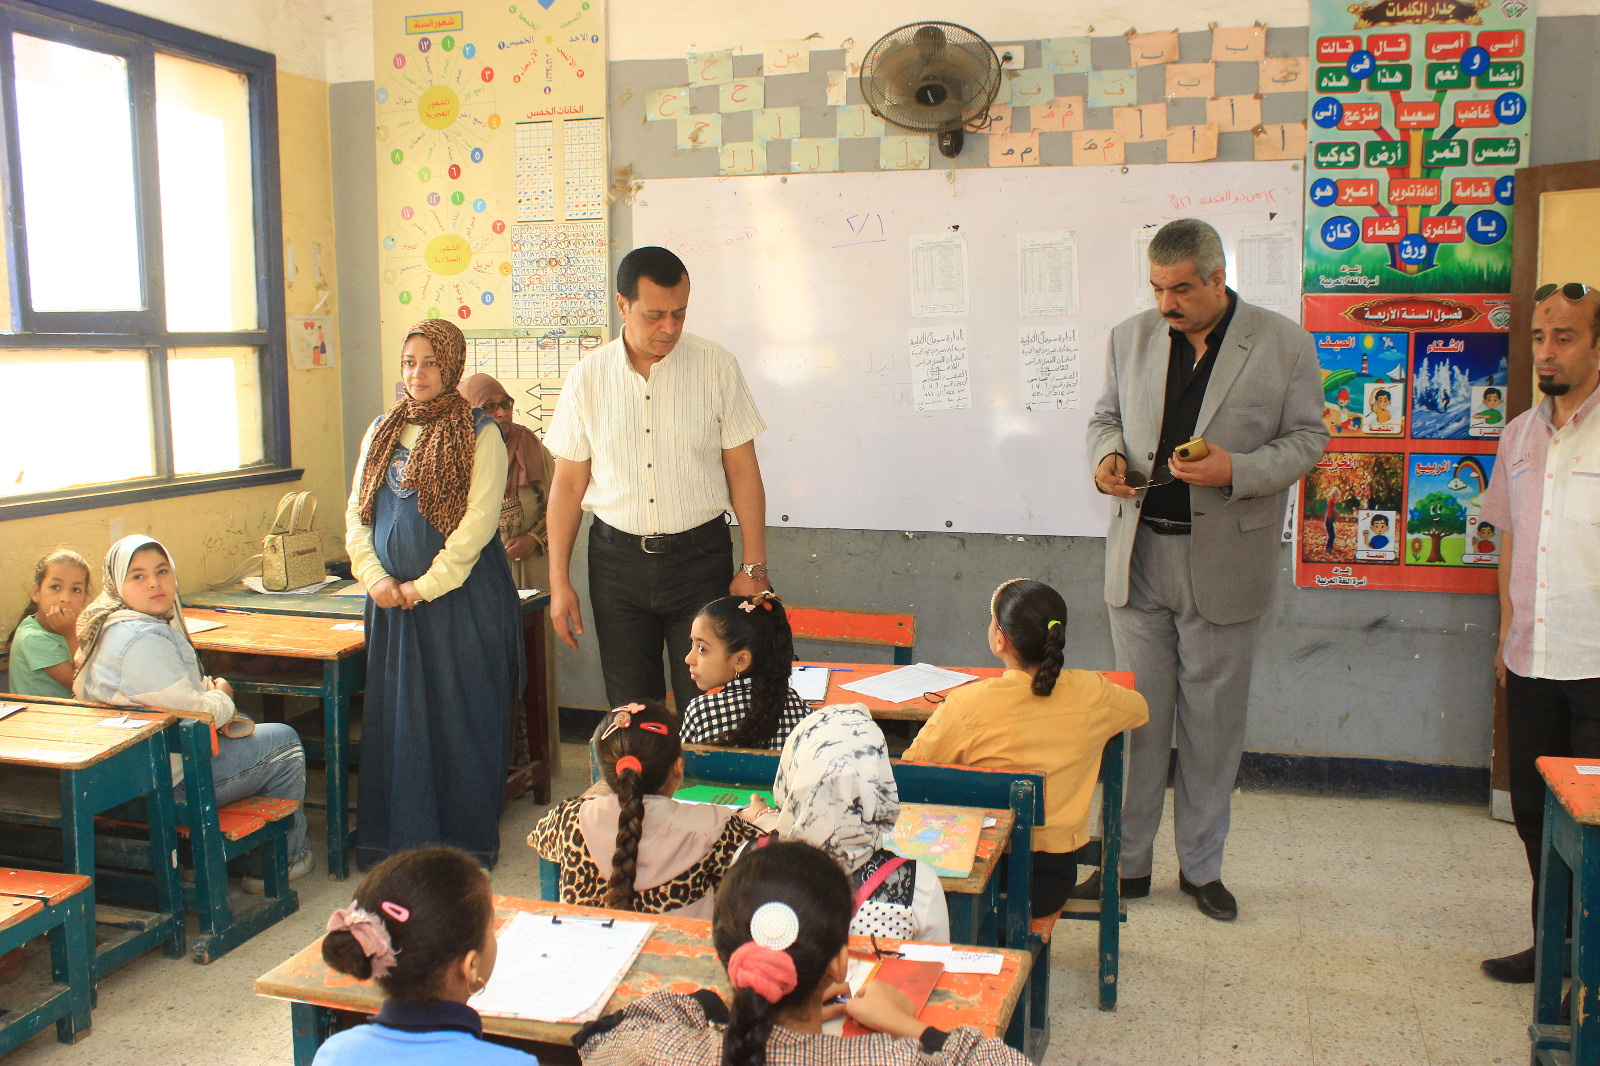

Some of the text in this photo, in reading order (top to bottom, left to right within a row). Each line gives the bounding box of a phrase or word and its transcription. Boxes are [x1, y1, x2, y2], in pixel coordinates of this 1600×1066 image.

[1385, 0, 1457, 18] جدار الكلمات
[1320, 39, 1354, 54] قالت
[1373, 39, 1407, 56] قال
[1469, 53, 1481, 70] و
[1320, 72, 1350, 88] هذه
[1377, 68, 1403, 84] هذا
[1434, 65, 1459, 86] نعم
[1488, 64, 1521, 87] أيضا
[526, 106, 556, 119] الخمس
[1399, 108, 1436, 123] سعيد
[1457, 104, 1491, 120] غاضب
[1500, 98, 1521, 117] أنا
[1343, 108, 1379, 127] منزعج
[1317, 144, 1356, 165] كوكب
[1368, 141, 1402, 165] أرض
[1427, 141, 1461, 163] قمر
[1474, 139, 1517, 163] شمس
[1312, 184, 1334, 201] هو
[1389, 183, 1438, 202] إعادة تدوير
[1455, 181, 1491, 198] قمامة
[1325, 222, 1353, 243] كان
[1366, 219, 1401, 238] فضاء
[1477, 216, 1497, 238] يا
[1401, 240, 1428, 260] ورق
[1401, 307, 1434, 321] السنة
[1433, 307, 1463, 322] فصول
[1318, 336, 1356, 351] الصيف
[1426, 338, 1465, 354] الشتاء
[1315, 455, 1358, 472] الخريف
[1414, 460, 1451, 476] الربيع
